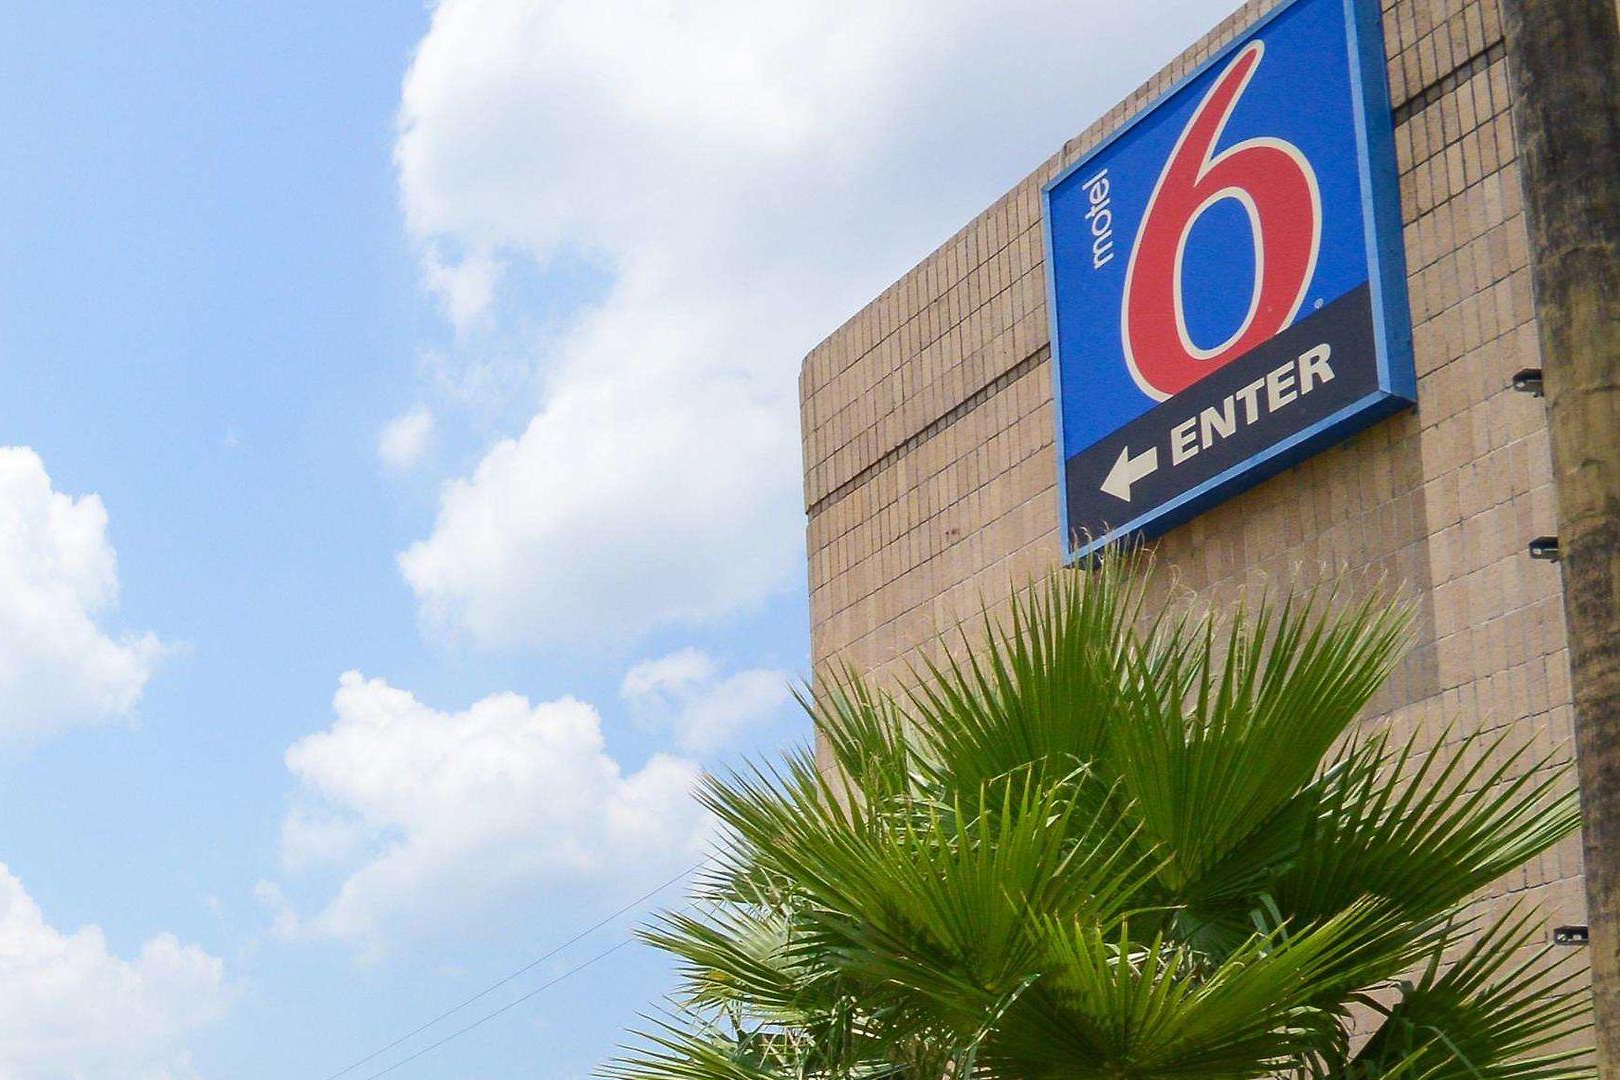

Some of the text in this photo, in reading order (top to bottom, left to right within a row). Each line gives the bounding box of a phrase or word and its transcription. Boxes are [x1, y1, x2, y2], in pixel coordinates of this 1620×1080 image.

[1082, 168, 1114, 270] motel
[1121, 39, 1322, 402] 6
[1170, 343, 1336, 467] ENTER
